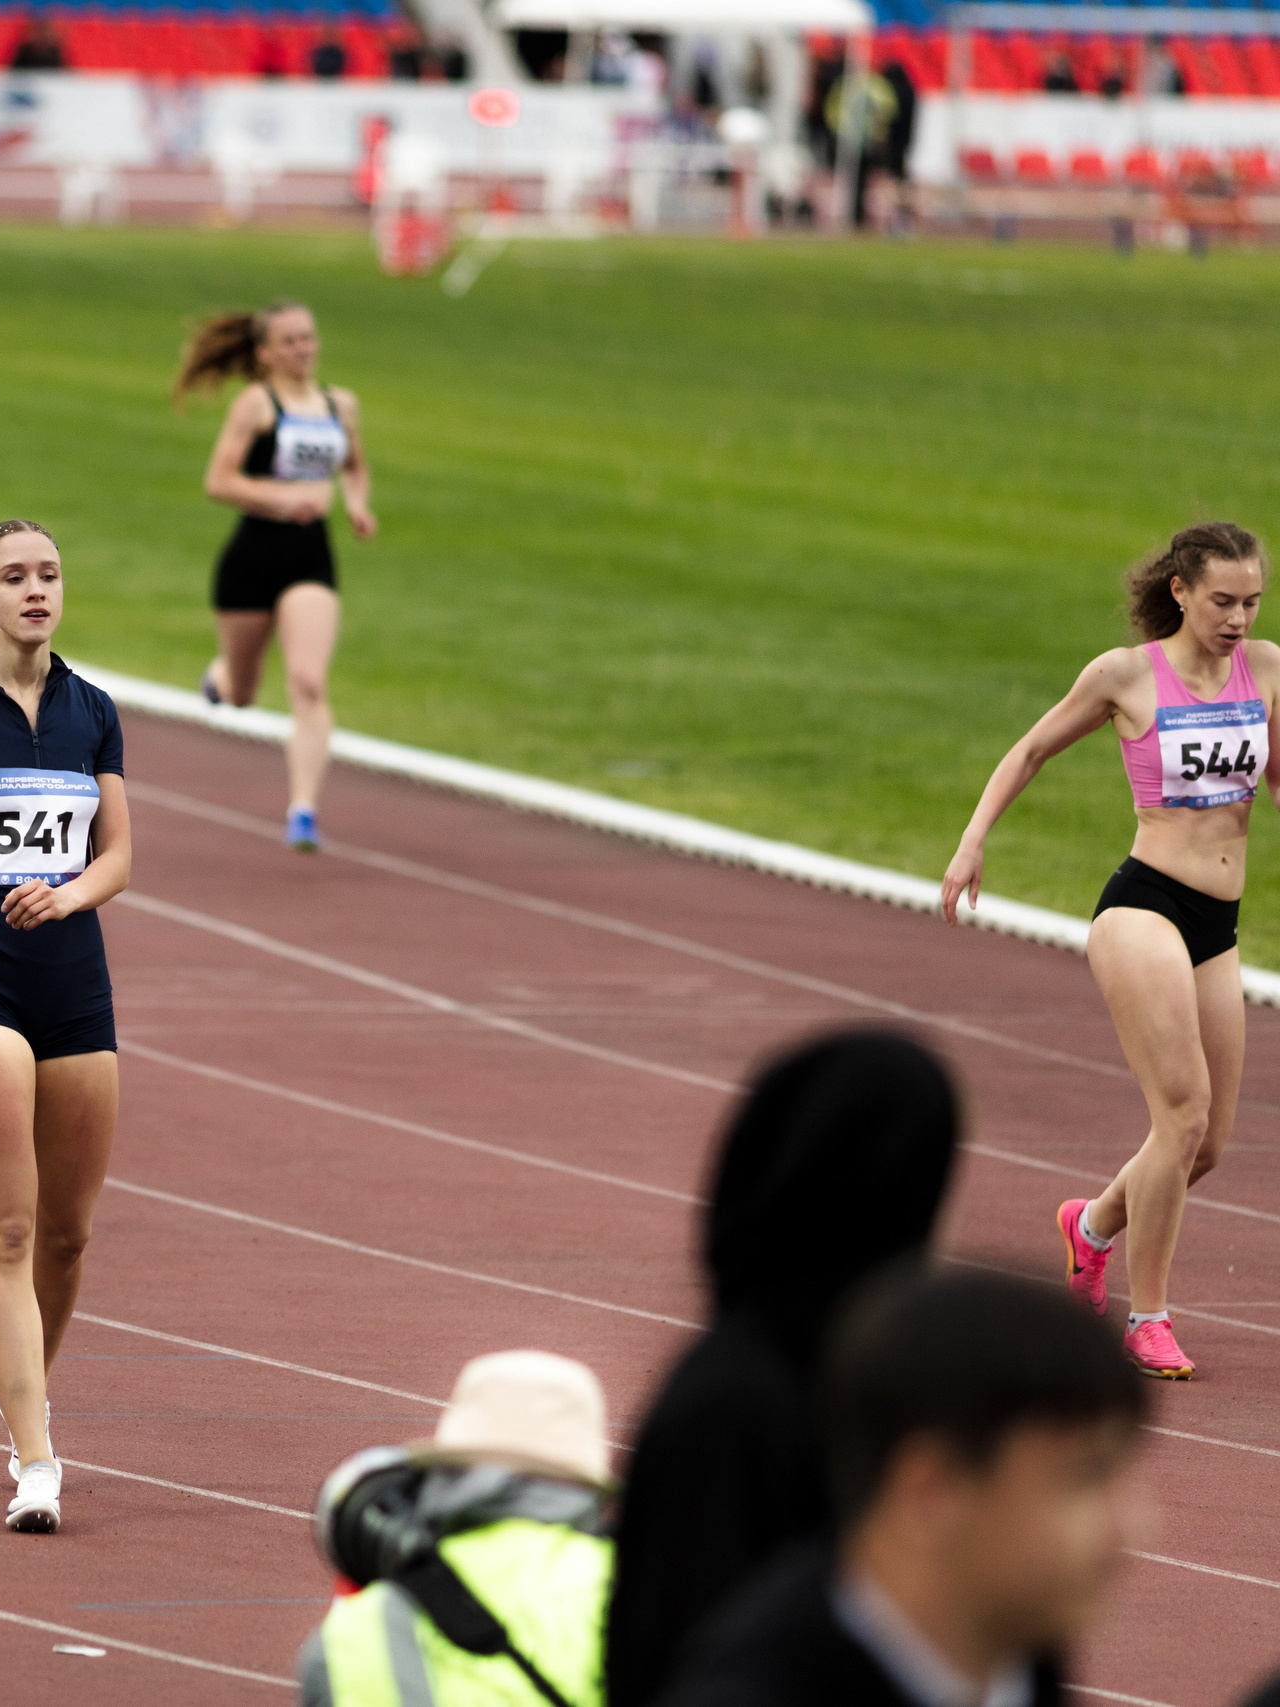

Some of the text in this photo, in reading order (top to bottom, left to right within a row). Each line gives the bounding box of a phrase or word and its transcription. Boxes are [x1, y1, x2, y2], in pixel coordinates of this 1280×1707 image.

[1180, 740, 1257, 781] 544
[54, 783, 92, 791] ОКРУГА
[16, 875, 50, 885] ВФА
